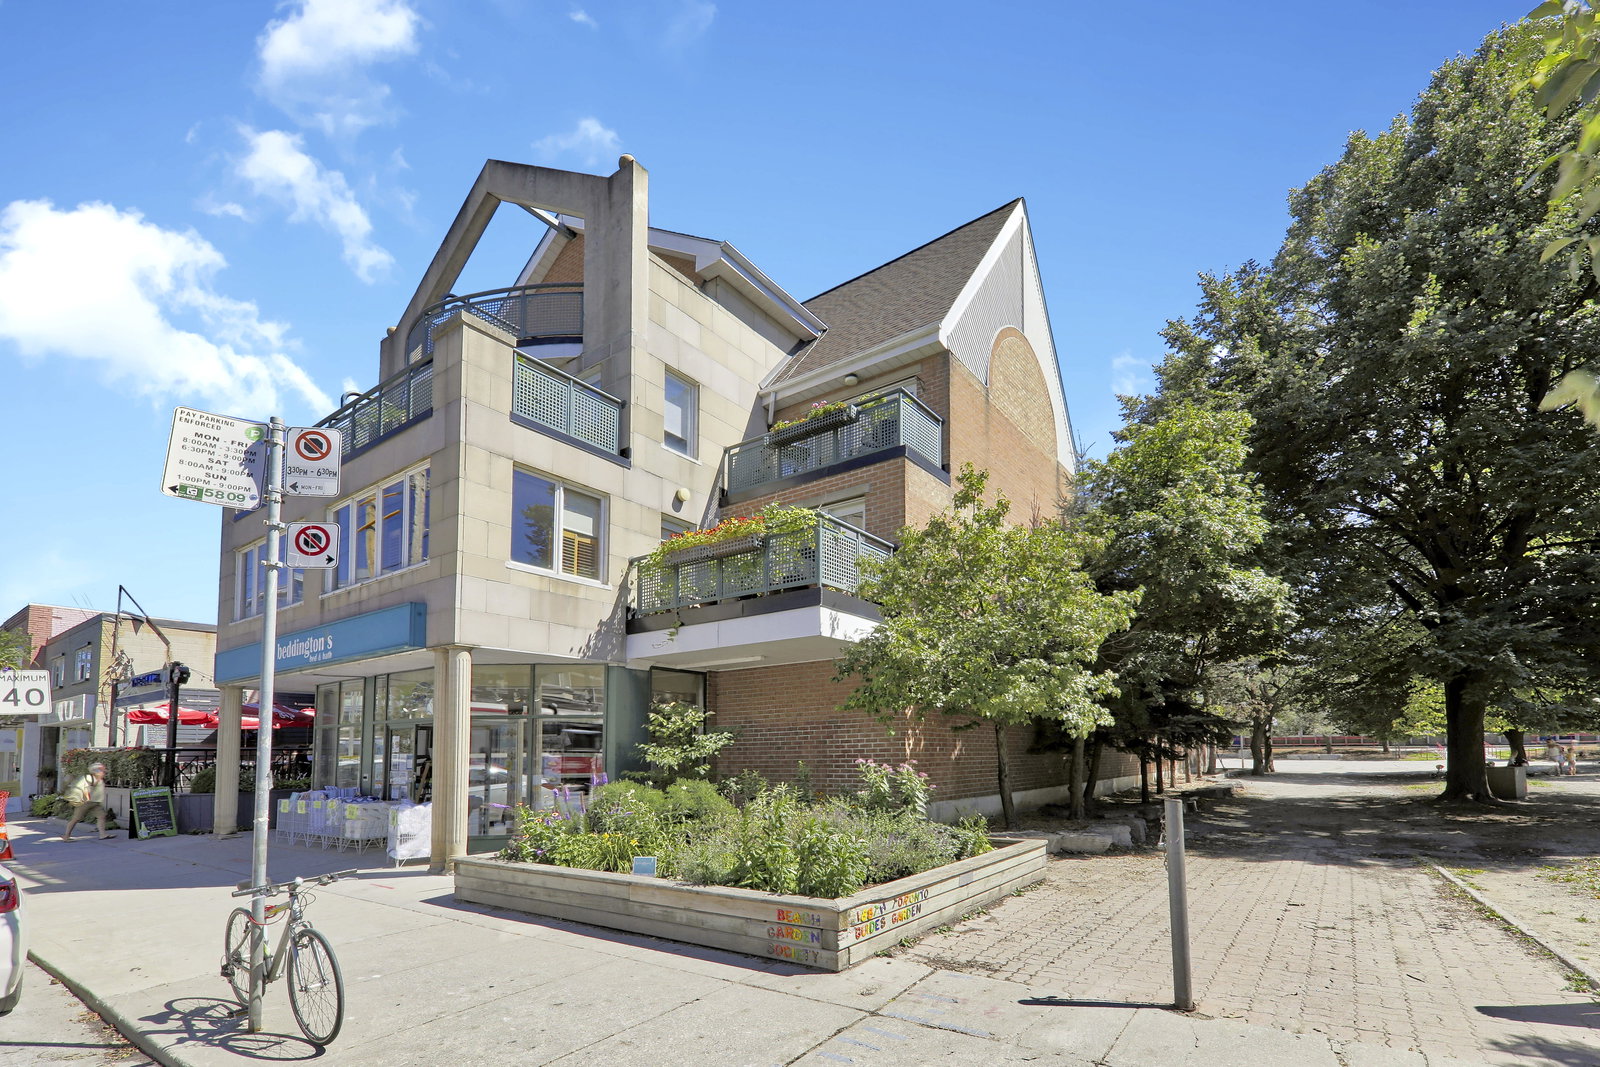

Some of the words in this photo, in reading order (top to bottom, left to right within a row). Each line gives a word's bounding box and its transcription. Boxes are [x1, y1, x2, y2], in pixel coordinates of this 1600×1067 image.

[179, 416, 222, 430] ENFORCED
[200, 414, 235, 427] PARKING
[194, 432, 220, 442] MON
[182, 437, 216, 449] 8:00AM
[225, 446, 256, 456] 3:30PM
[182, 445, 215, 456] 6:30PM
[224, 453, 255, 464] 9:00PM
[178, 459, 213, 471] 8:00AM
[222, 468, 253, 478] 9:00PM
[208, 457, 229, 466] SAT
[177, 474, 210, 485] 1:00PM
[219, 482, 251, 492] 9:00PM
[205, 472, 227, 481] SUN
[2, 688, 44, 706] 40
[892, 889, 929, 909] TORONTO
[776, 908, 821, 927] BEACH
[854, 917, 886, 940] GUIDES
[891, 904, 922, 924] GARDEN
[767, 926, 821, 944] GARDEN
[767, 943, 820, 963] SOCIETY
